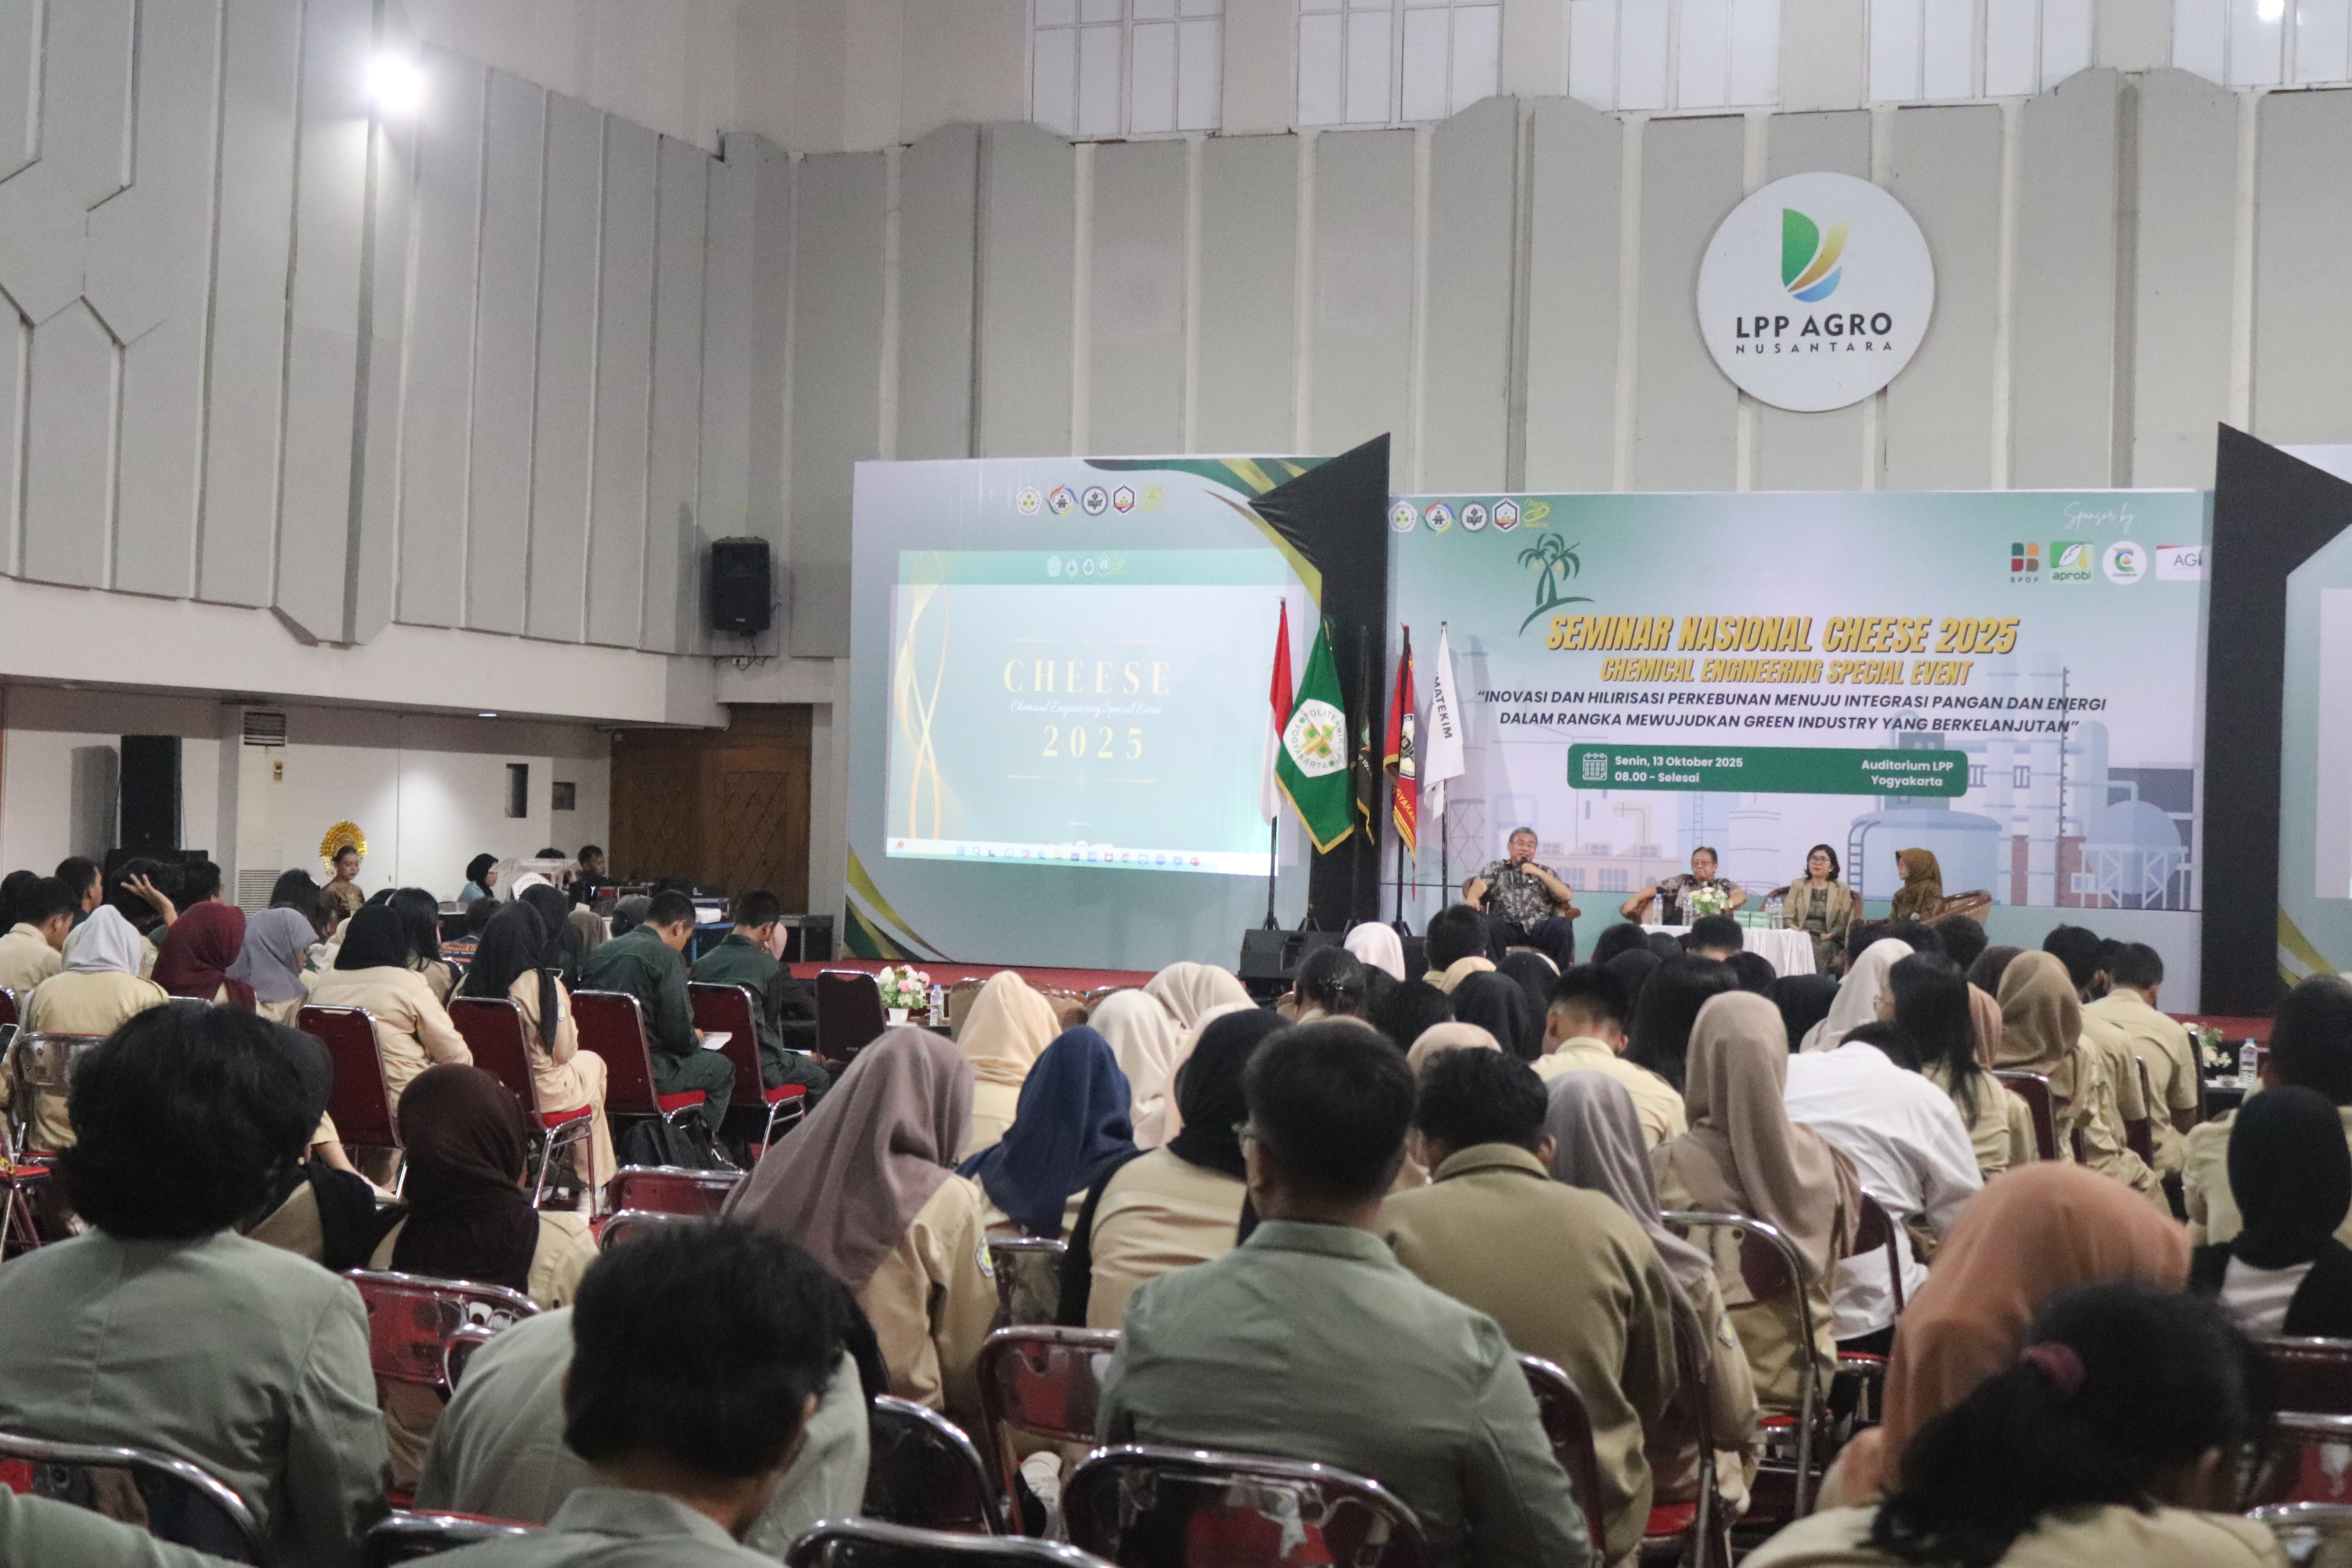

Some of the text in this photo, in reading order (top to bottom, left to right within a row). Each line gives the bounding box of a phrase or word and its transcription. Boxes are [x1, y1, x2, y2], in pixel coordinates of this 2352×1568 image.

[1736, 312, 1892, 338] LPP AGRO
[1736, 341, 1892, 354] NUSANTARA
[2063, 502, 2136, 535] Sponsor by
[2052, 570, 2091, 581] aprobi
[1546, 615, 2020, 654] SEMINAR NASIONAL CHEESE 2025
[1004, 659, 1170, 694] CHEESE
[1599, 657, 1974, 686] CHEMICAL ENGINEERING SPECIAL EVENT
[1011, 699, 1161, 719] Chemical Engineering Special Event
[1551, 691, 1584, 704] DAN
[1588, 692, 1664, 704] HILIRISASI
[1668, 693, 1770, 705] PERKEBUNAN
[1775, 694, 1841, 707] MENUJU
[1844, 695, 1929, 708] INTEGRASI
[1932, 696, 2004, 710] PANGAN
[2007, 697, 2046, 710] DAN
[2048, 698, 2107, 711] ENERGI
[1303, 709, 1344, 744] POLITEKNIK
[1499, 713, 1554, 724] DALAM
[1557, 713, 1622, 725] RANGKA
[1626, 714, 1740, 727] MEWUJUDKAN
[1744, 716, 1795, 728] GREEN
[1798, 717, 1878, 730] INDUSTRY
[1882, 718, 1928, 731] YANG
[1042, 725, 1143, 759] 2025
[1291, 724, 1328, 769] YOGYAKARTA
[1615, 755, 1743, 767] Senin, 13 Oktober 2025
[1861, 759, 1954, 771] Auditorium LPP
[1614, 771, 1647, 781] 08.00
[1658, 772, 1700, 783] Selesai
[1871, 775, 1943, 789] Yogyakarta
